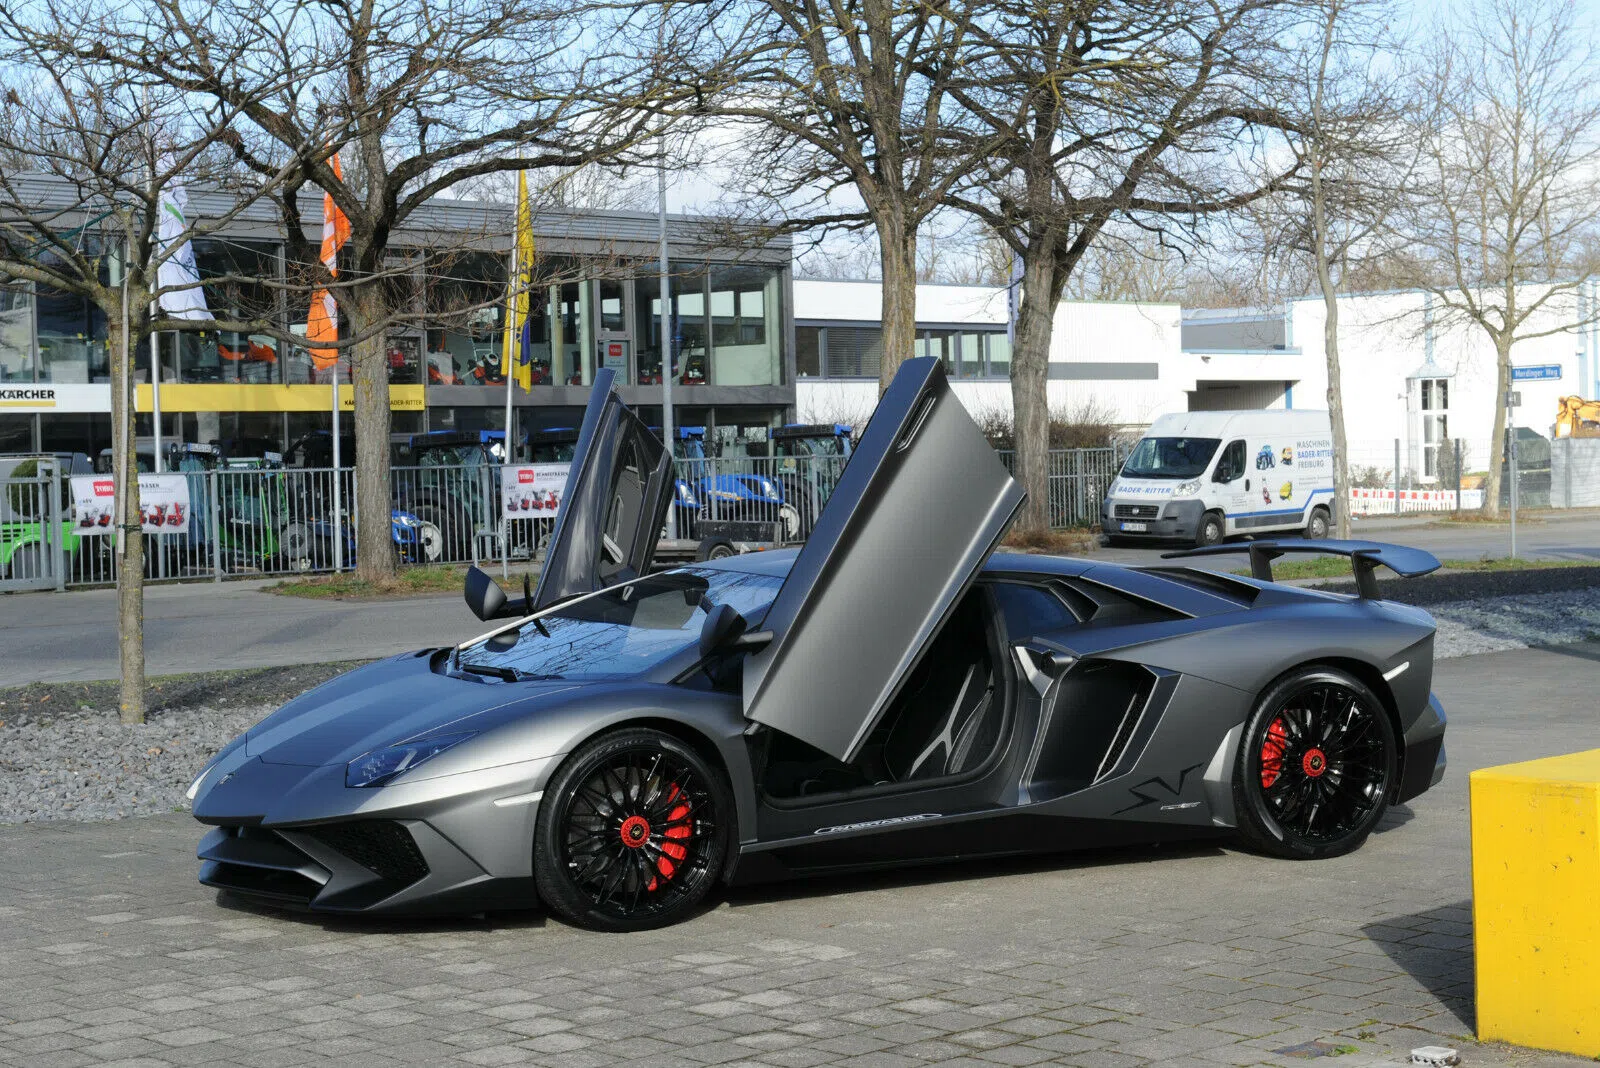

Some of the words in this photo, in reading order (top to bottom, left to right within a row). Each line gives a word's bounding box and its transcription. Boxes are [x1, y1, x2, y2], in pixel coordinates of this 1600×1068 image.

[1296, 440, 1330, 449] MASCHINEN
[1298, 459, 1325, 469] FREIBURG
[1118, 486, 1172, 494] BADER-RITTER
